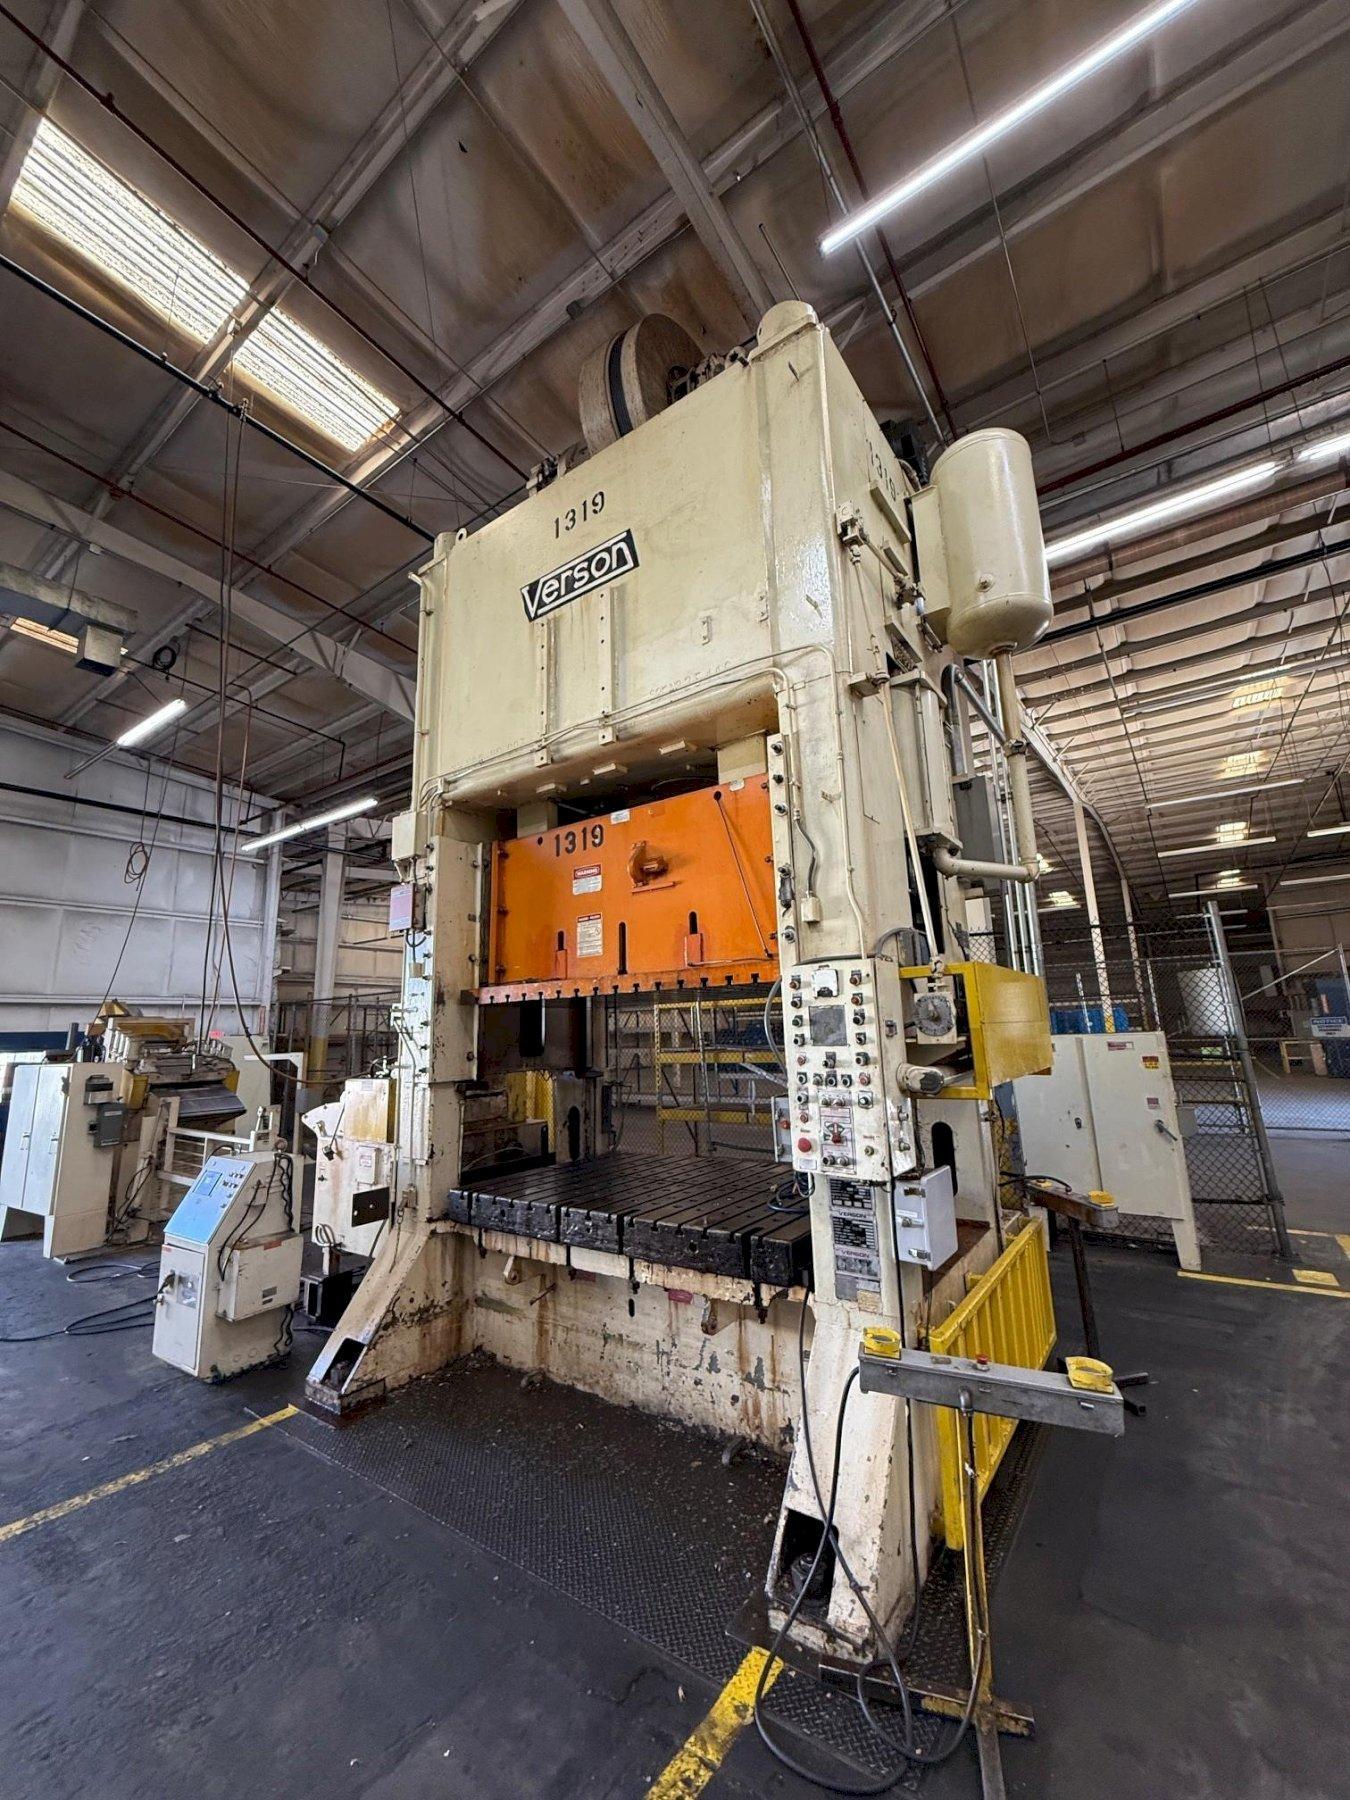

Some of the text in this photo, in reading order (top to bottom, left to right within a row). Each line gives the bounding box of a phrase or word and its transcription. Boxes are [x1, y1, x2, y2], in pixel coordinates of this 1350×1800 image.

[554, 491, 605, 539] 1319
[521, 532, 635, 619] Verson
[554, 824, 604, 857] 1319
